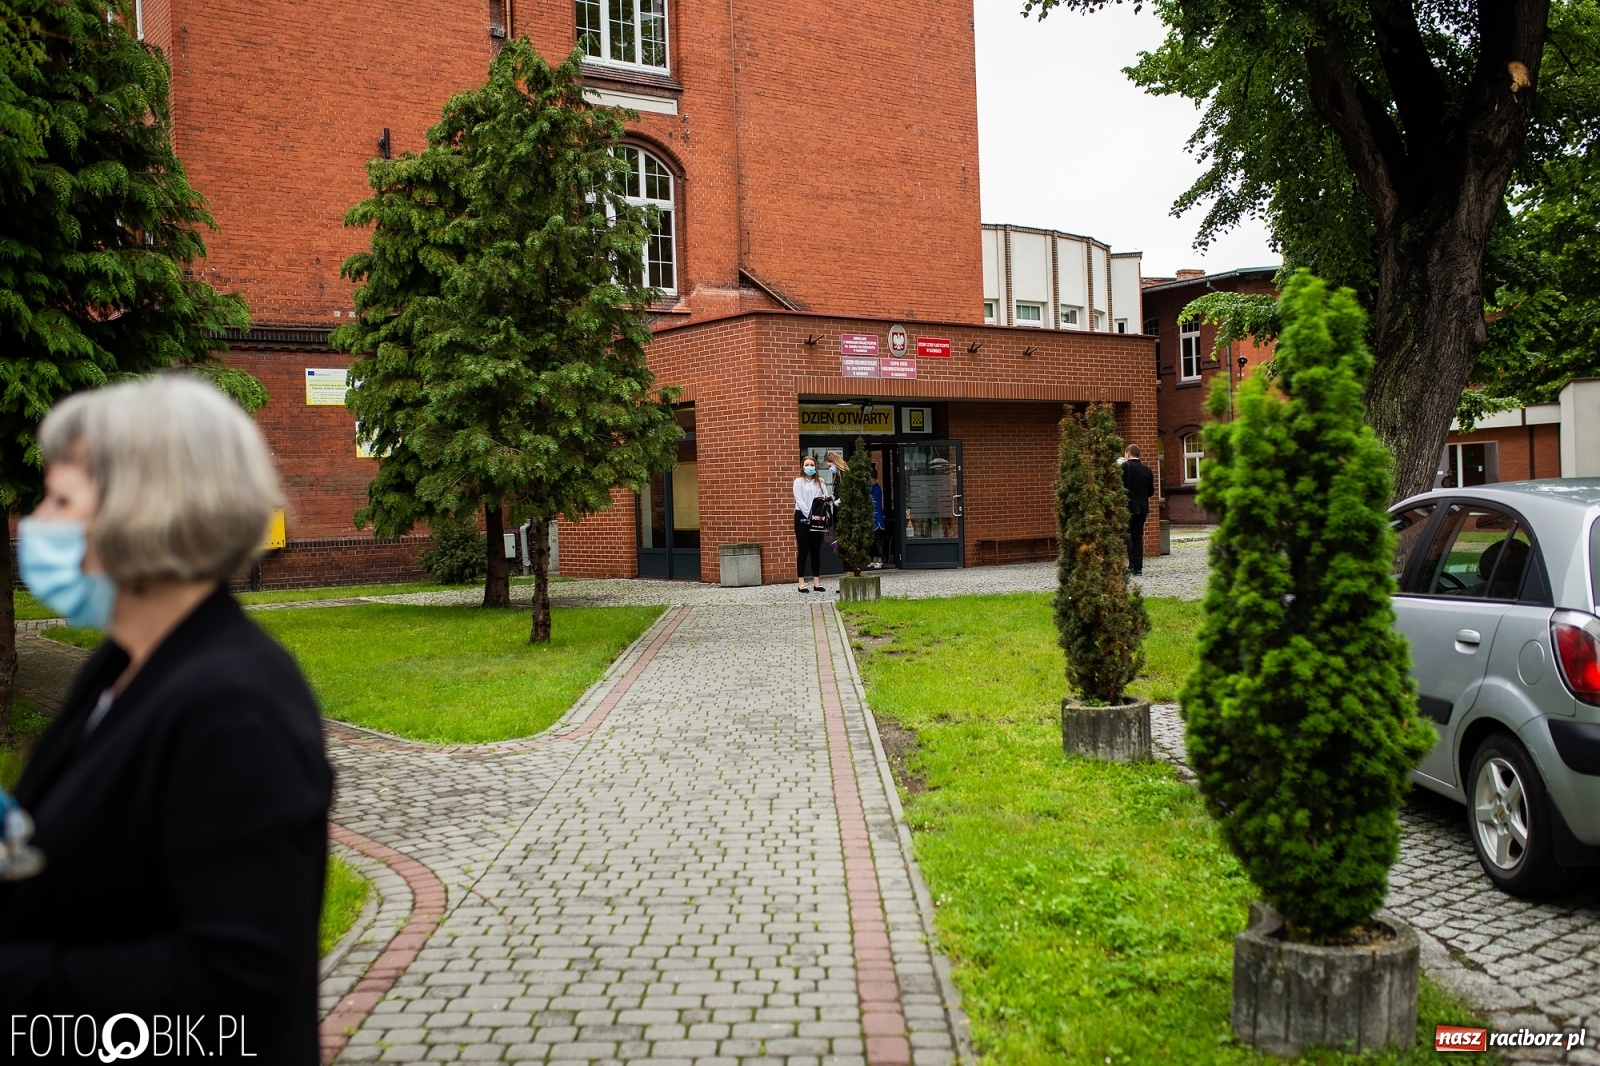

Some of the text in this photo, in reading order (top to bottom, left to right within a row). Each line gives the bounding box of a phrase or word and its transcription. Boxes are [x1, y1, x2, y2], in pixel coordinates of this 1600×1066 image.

[801, 408, 890, 425] DZIEŃ OTWARTY
[829, 424, 865, 432] zapraszamy
